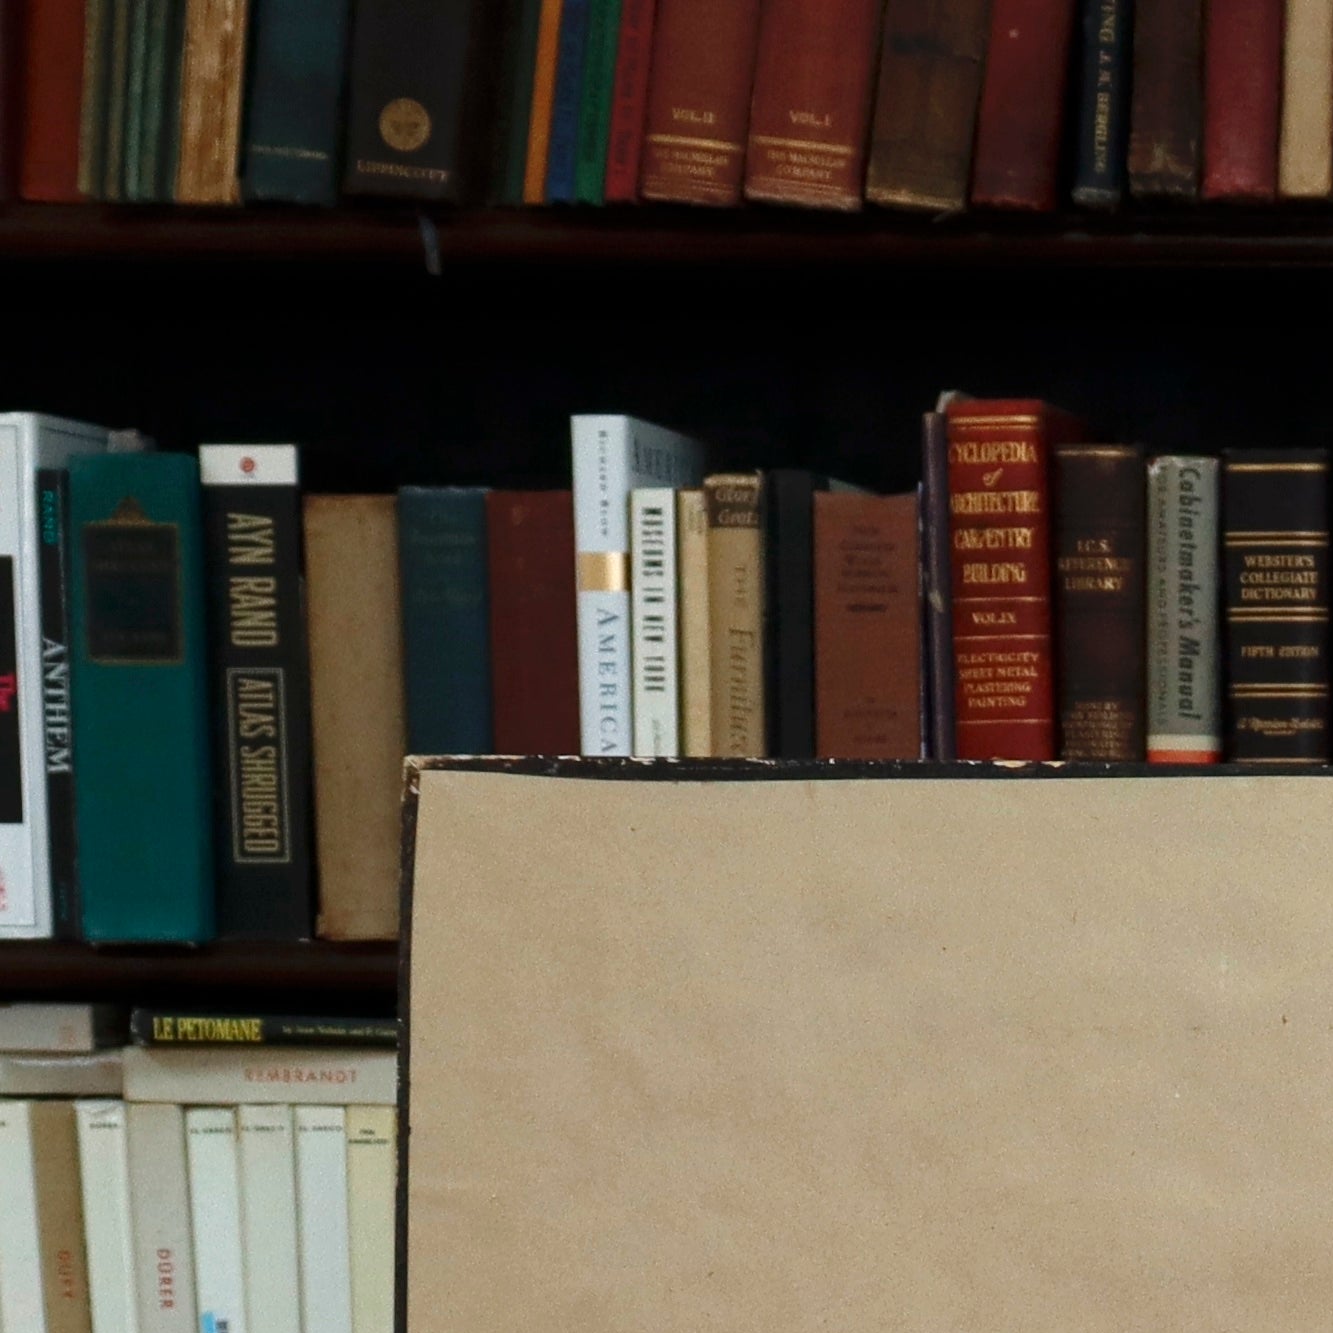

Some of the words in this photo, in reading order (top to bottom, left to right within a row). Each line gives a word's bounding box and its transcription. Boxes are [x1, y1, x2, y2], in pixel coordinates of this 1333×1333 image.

[227, 513, 276, 565] AYN
[640, 508, 665, 577] MUSEUMS
[1178, 467, 1201, 629] Cabinetmaker's
[1240, 572, 1319, 584] COLLEGIATE
[1244, 556, 1315, 568] WEBSTER'S
[641, 588, 665, 602] IN
[1065, 577, 1124, 591] LIBRARY
[1241, 588, 1318, 600] DICTIONARY
[229, 576, 280, 648] RAND
[641, 616, 665, 642] NEW
[642, 657, 665, 693] YORK
[1178, 635, 1201, 720] Manual
[41, 636, 72, 774] ANTHEM
[238, 678, 274, 736] ATLAS
[239, 743, 281, 857] SHRUGGED
[153, 1017, 174, 1040] LE
[176, 1017, 261, 1041] PETOMANE
[245, 1068, 357, 1082] REMBRANDT
